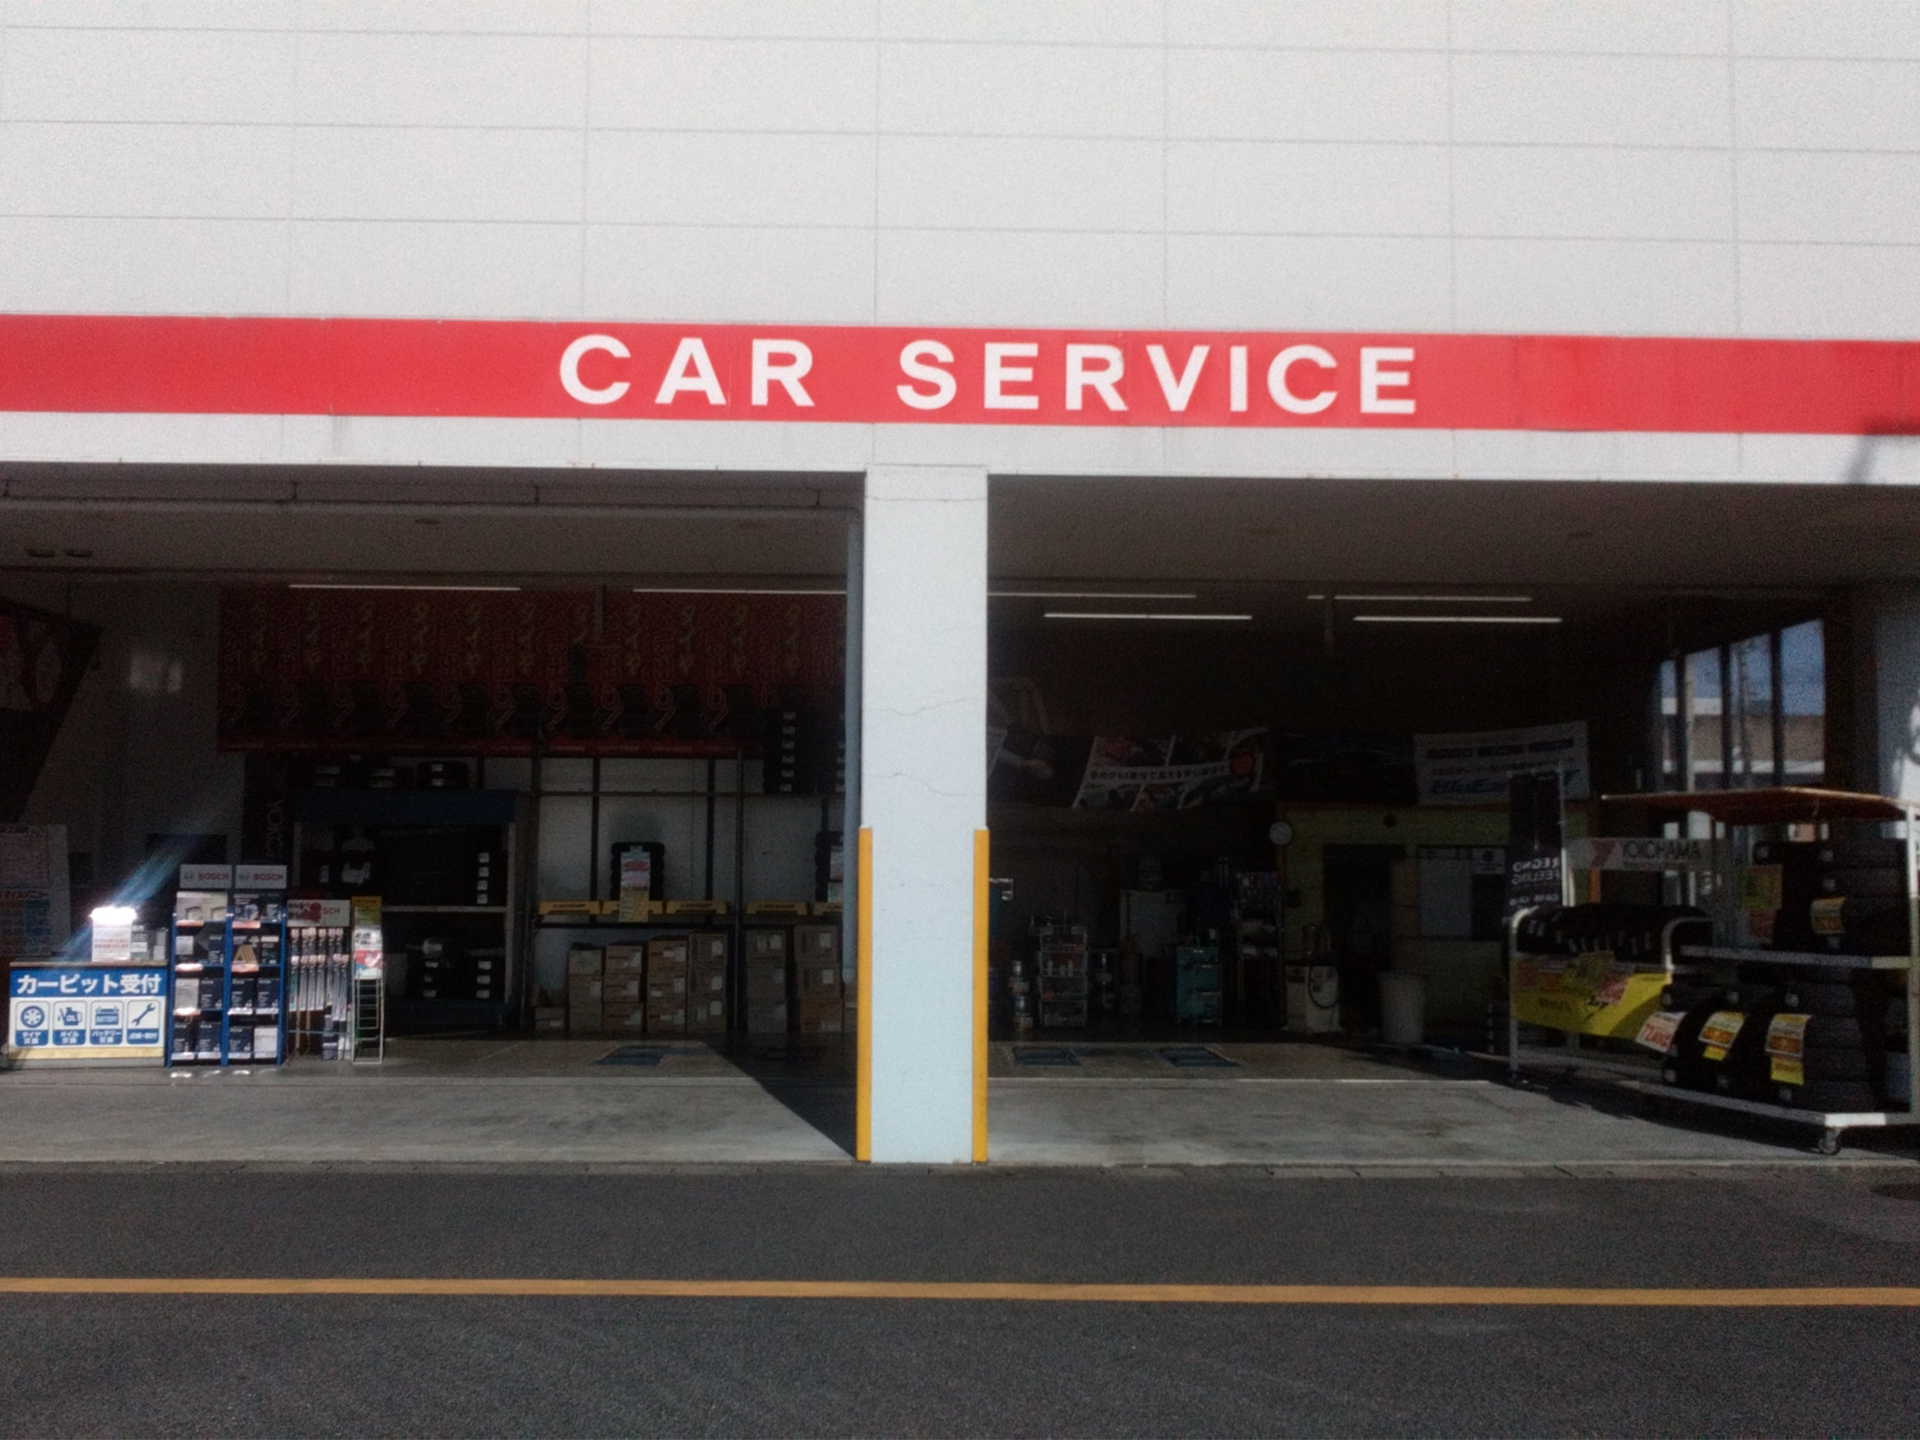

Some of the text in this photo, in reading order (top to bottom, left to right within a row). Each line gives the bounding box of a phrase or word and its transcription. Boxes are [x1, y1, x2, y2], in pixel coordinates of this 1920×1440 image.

[559, 333, 1416, 415] CAR SERVICE
[198, 872, 229, 881] BOSCH
[252, 873, 284, 881] BOSCH
[16, 973, 162, 995] カーピット受付
